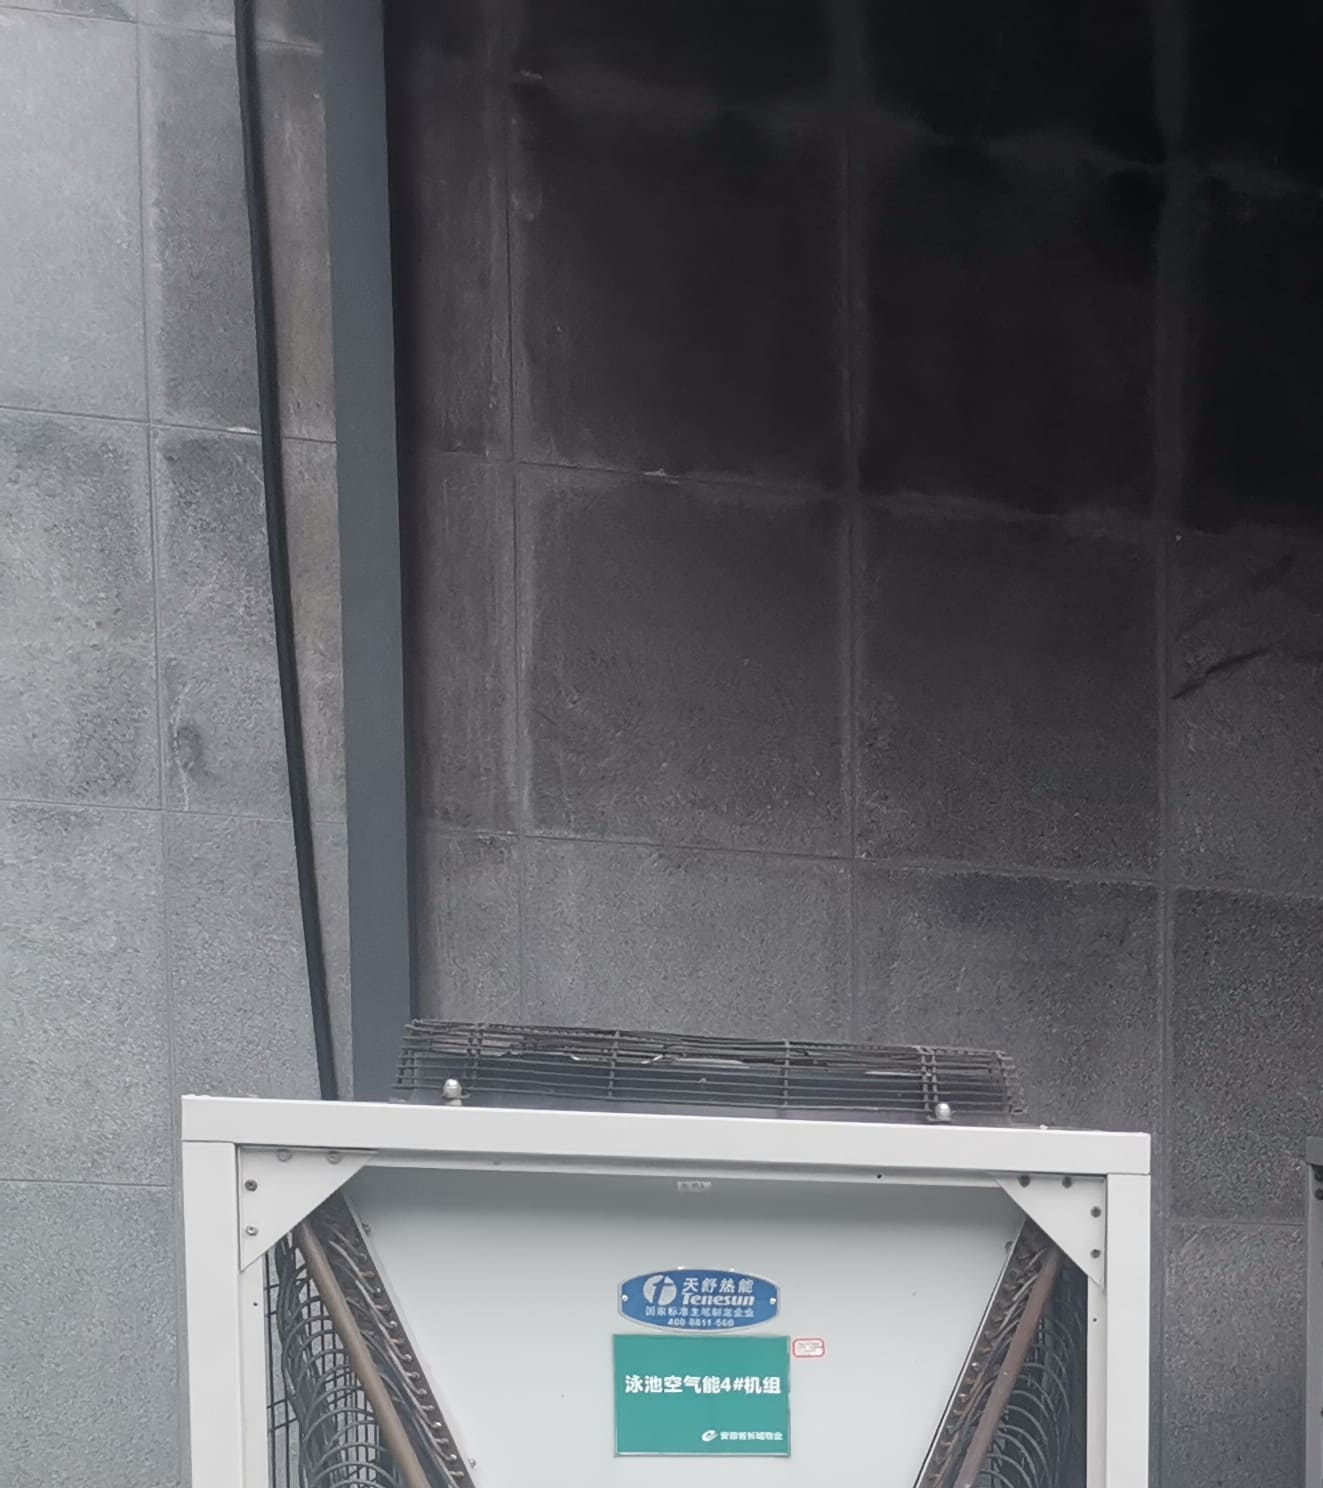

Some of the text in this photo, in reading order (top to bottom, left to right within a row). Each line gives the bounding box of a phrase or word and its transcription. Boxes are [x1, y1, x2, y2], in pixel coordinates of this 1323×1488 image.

[682, 1277, 754, 1293] 天舒热能
[681, 1292, 755, 1306] Tenesun
[625, 1375, 781, 1394] 泳池空气能4#机组
